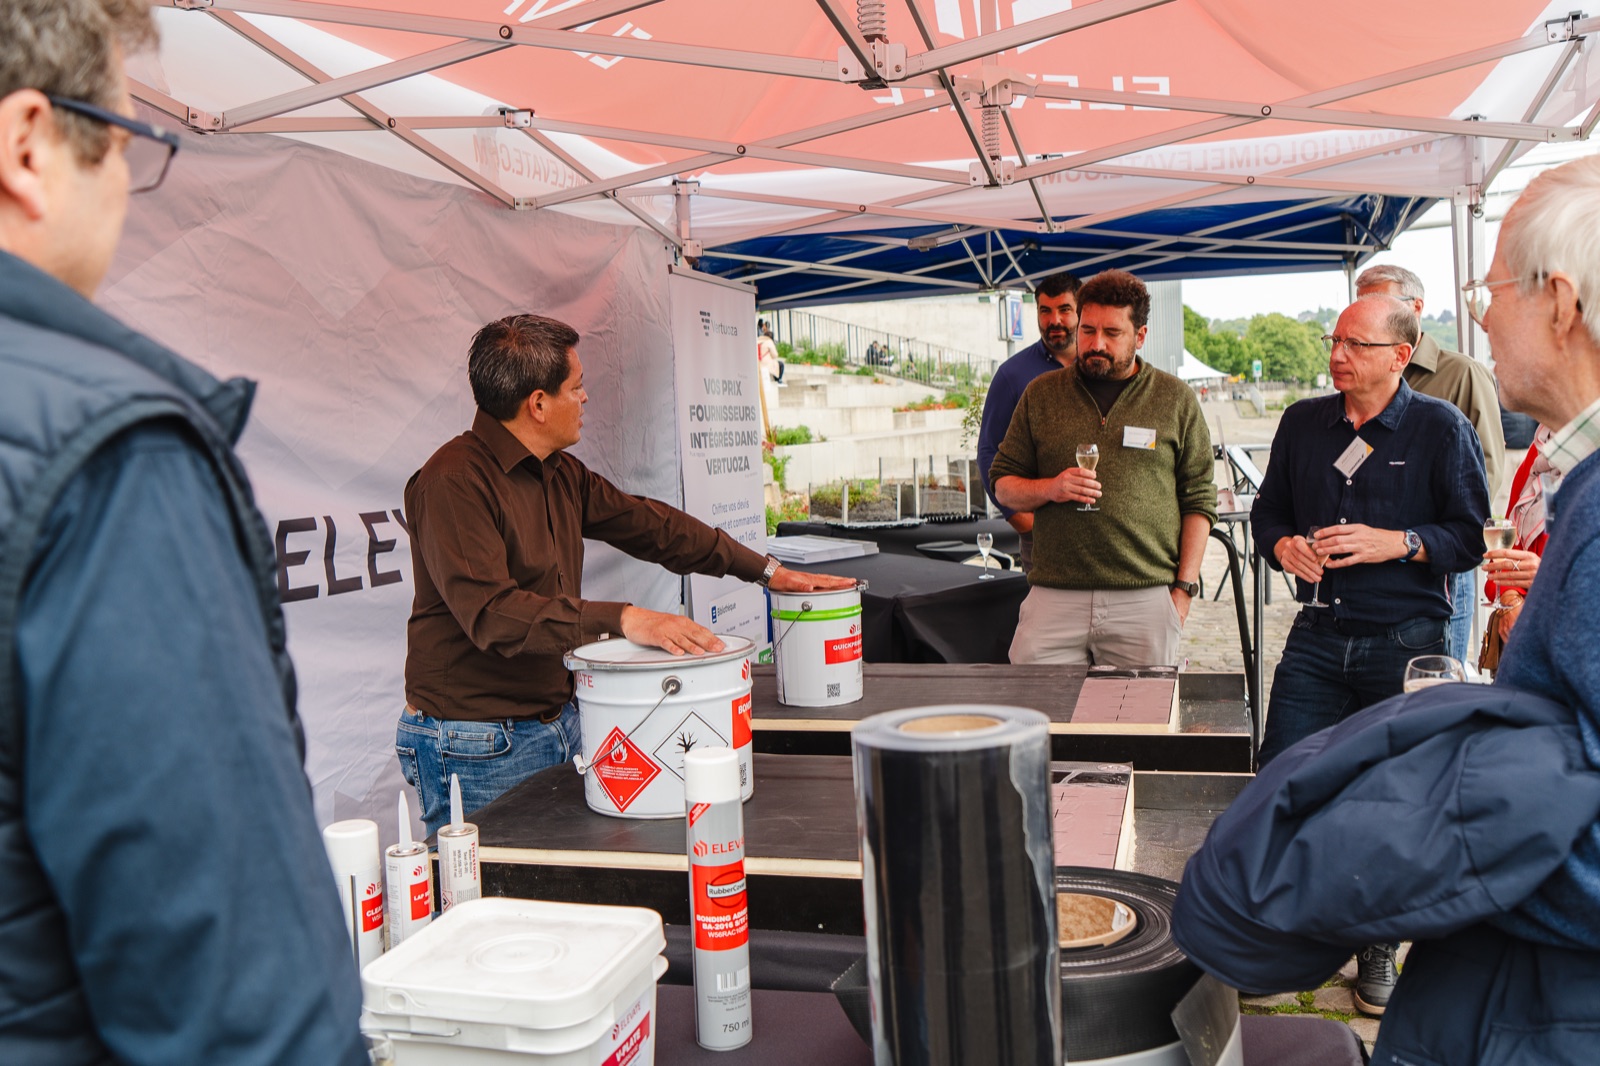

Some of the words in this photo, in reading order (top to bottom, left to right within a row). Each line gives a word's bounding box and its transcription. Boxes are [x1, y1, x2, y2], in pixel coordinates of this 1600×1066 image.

[711, 319, 738, 337] Vertuoza
[703, 378, 721, 395] VOS
[722, 379, 742, 396] PRIX
[689, 404, 756, 422] FOURNISSEURS
[690, 427, 735, 449] INTÉGRÉS
[735, 430, 759, 447] DANS
[706, 455, 750, 476] VERTUOZA
[728, 502, 737, 512] vos
[736, 498, 750, 511] devis
[696, 913, 731, 923] BONDING
[722, 1021, 740, 1033] 750
